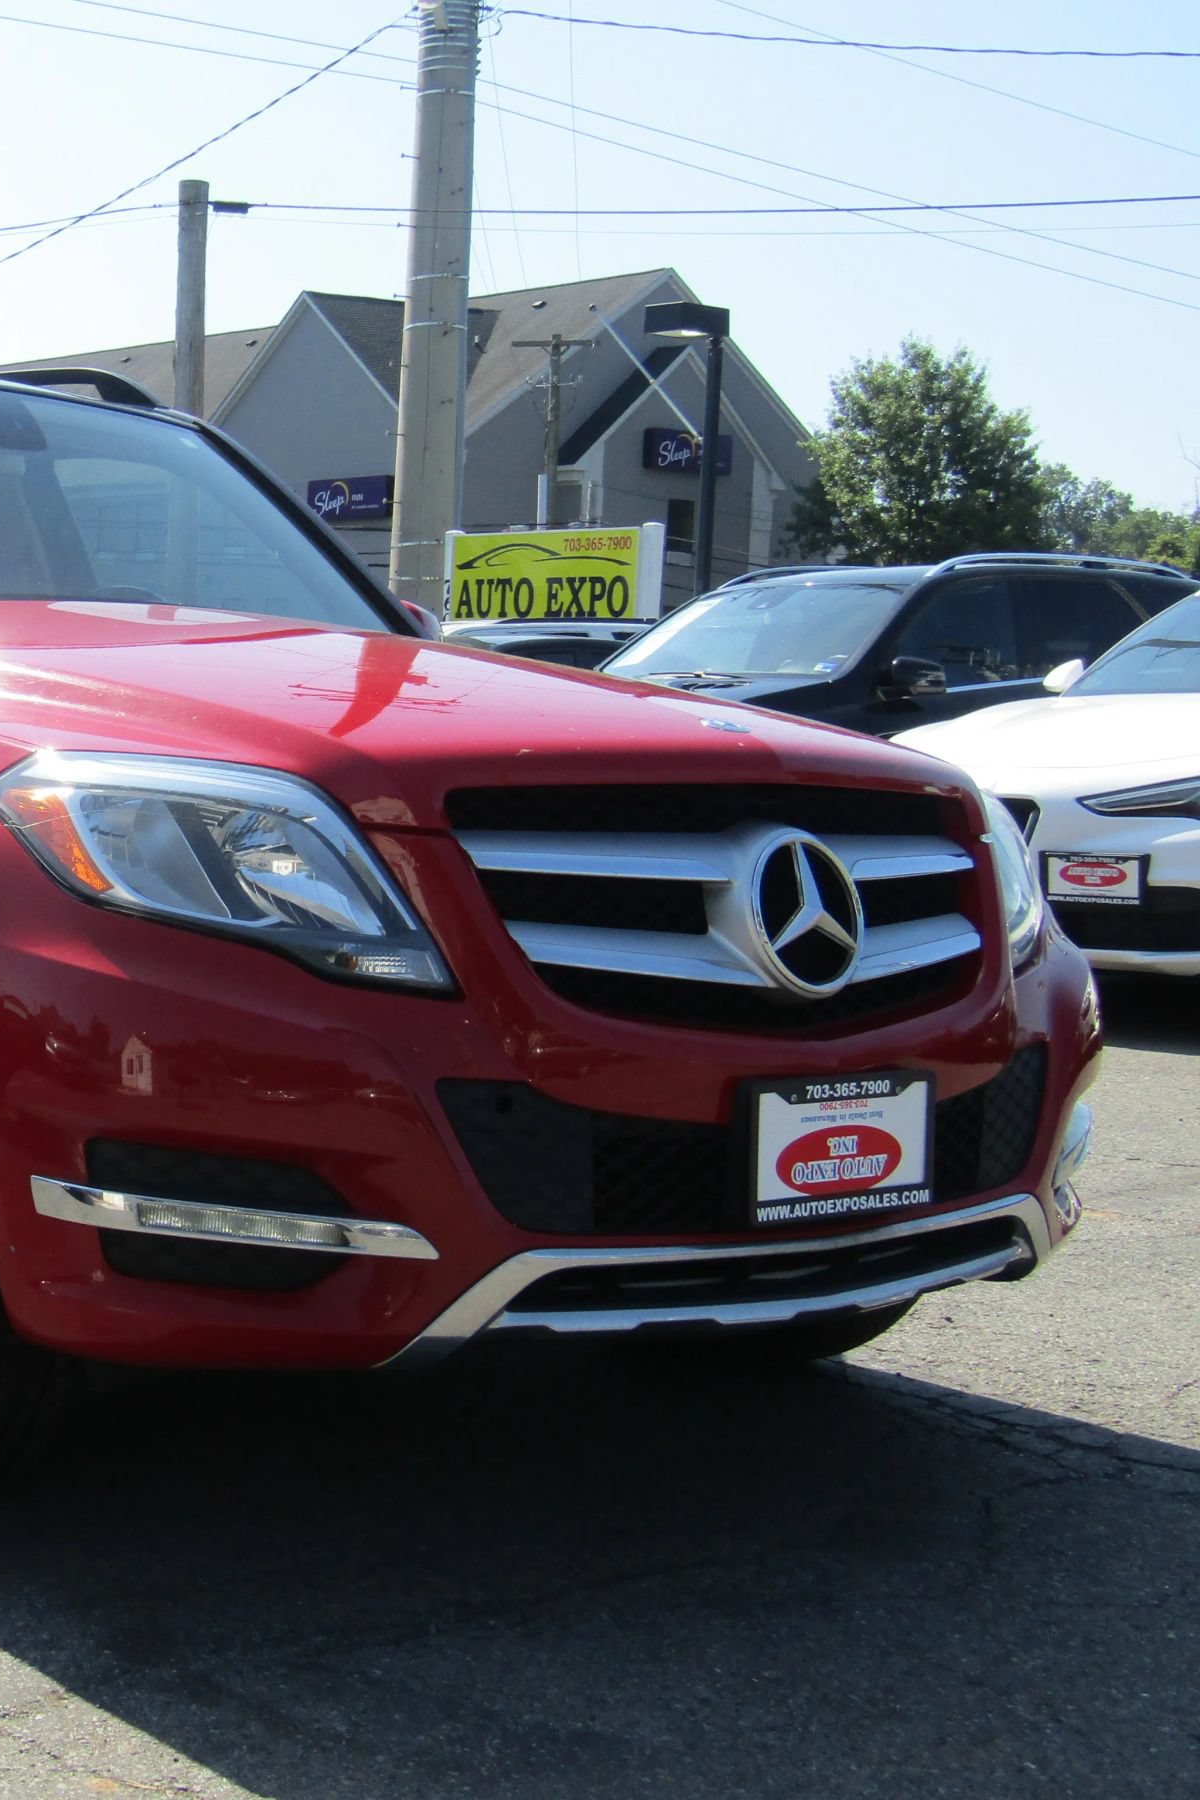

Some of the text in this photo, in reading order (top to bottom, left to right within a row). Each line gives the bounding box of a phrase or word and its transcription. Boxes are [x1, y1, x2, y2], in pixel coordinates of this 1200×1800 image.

[658, 440, 691, 467] Sleep
[312, 490, 364, 516] Sleep INN
[563, 536, 632, 552] 703-365-7900
[455, 575, 629, 618] AUTO EXPO
[805, 1079, 891, 1100] 703-365-7900
[819, 1100, 869, 1111] 703-365-7900
[827, 1136, 857, 1155] INC.
[791, 1154, 887, 1184] AUTO EXPO
[756, 1189, 930, 1222] WWW.AUTOEXPOSALES.COM
